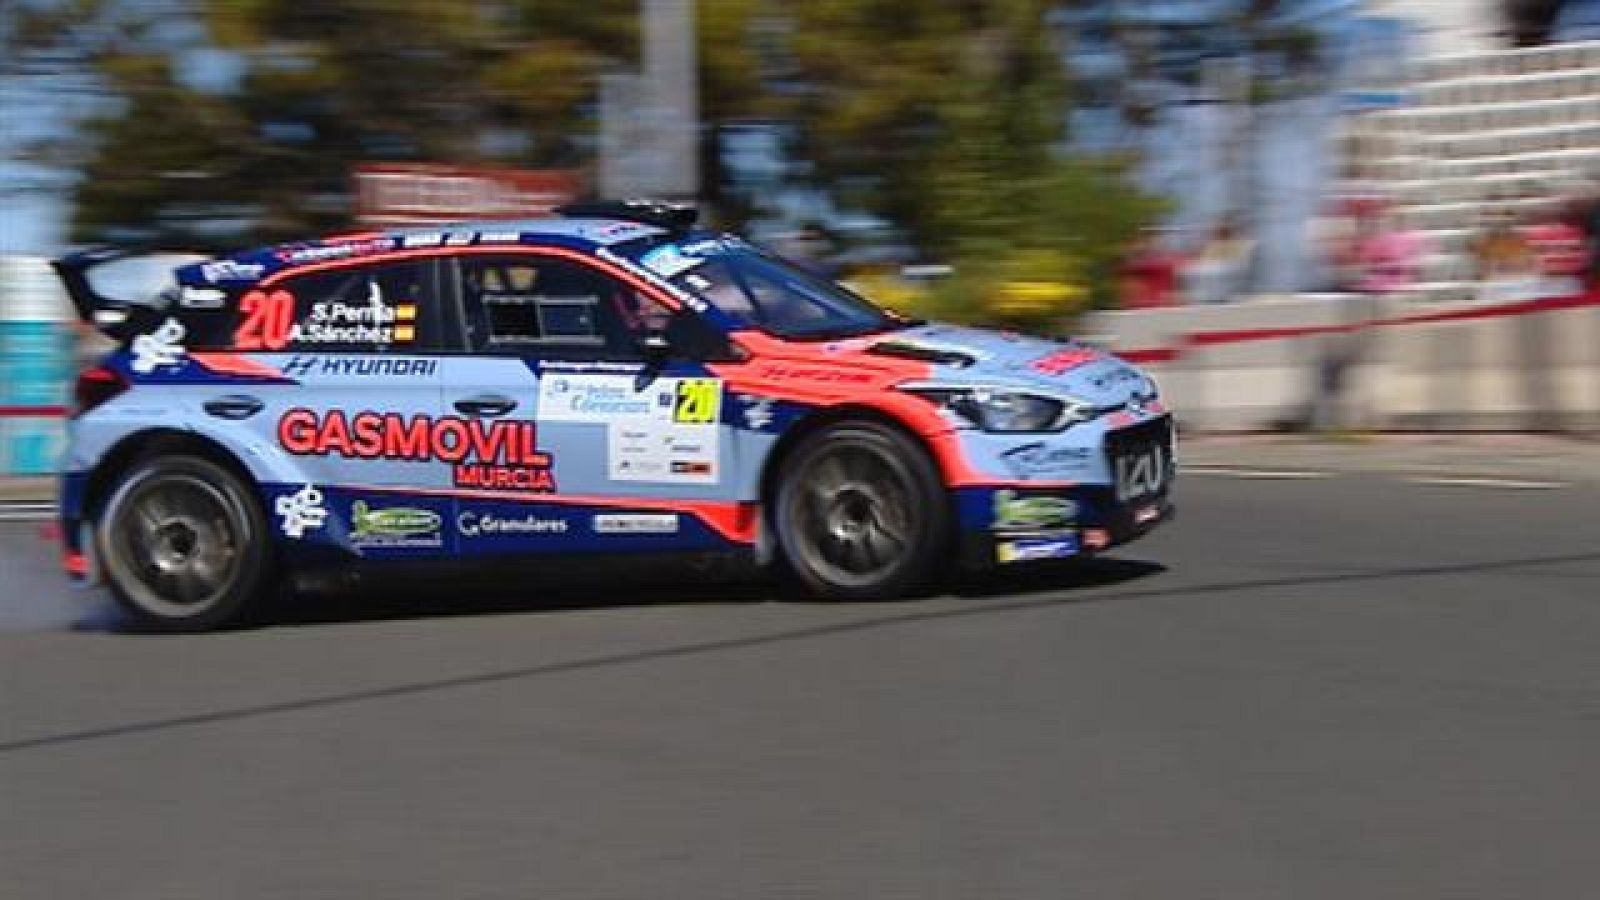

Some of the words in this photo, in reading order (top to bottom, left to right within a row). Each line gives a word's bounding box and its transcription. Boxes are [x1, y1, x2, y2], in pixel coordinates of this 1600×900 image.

[234, 289, 297, 349] 20
[322, 358, 438, 376] HYUNDAI
[673, 379, 722, 424] 20
[278, 408, 553, 467] GASMOVIL
[455, 464, 556, 493] MURCIA
